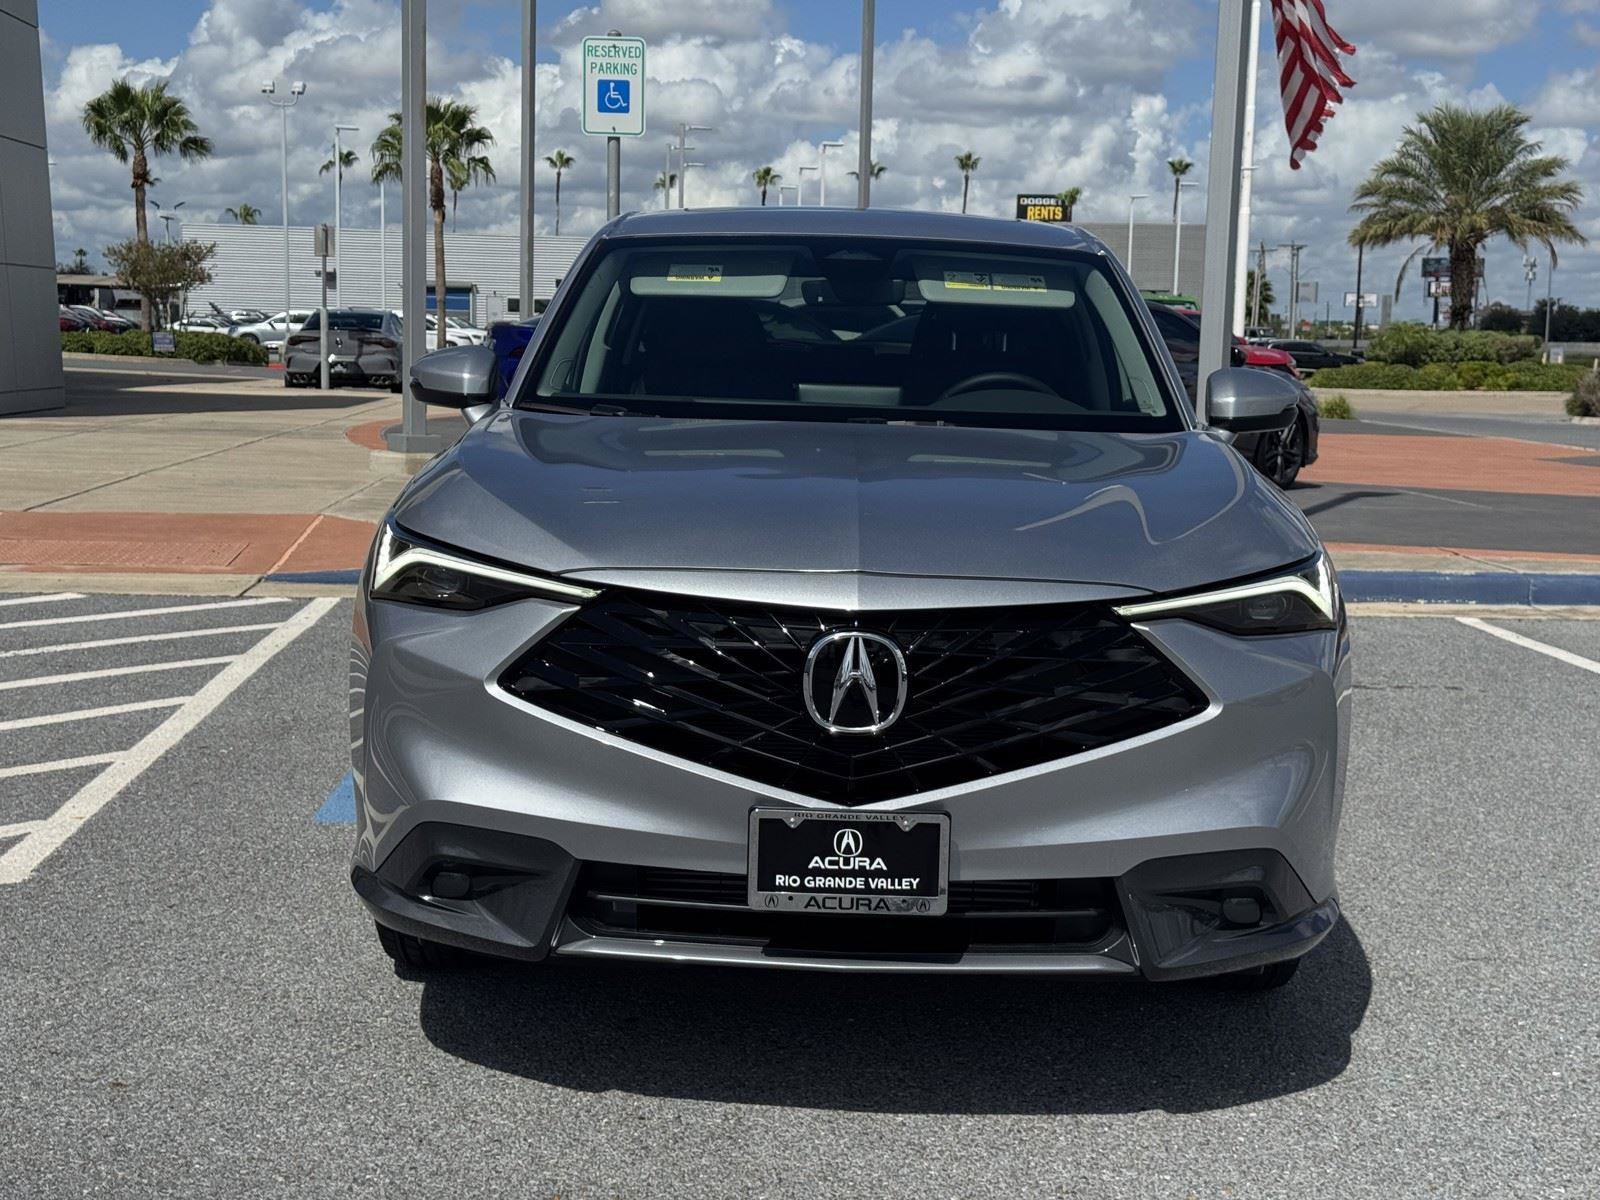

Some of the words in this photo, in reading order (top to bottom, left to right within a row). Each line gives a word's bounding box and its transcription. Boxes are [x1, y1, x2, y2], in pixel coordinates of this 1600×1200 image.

[587, 45, 641, 58] RESERVED
[590, 62, 638, 75] PARKING
[1027, 205, 1063, 221] RENTS
[807, 856, 888, 871] ACURA
[775, 874, 800, 887] RIO
[804, 876, 865, 889] GRANDE
[868, 877, 920, 890] VALLEY
[803, 896, 891, 912] ACURA
